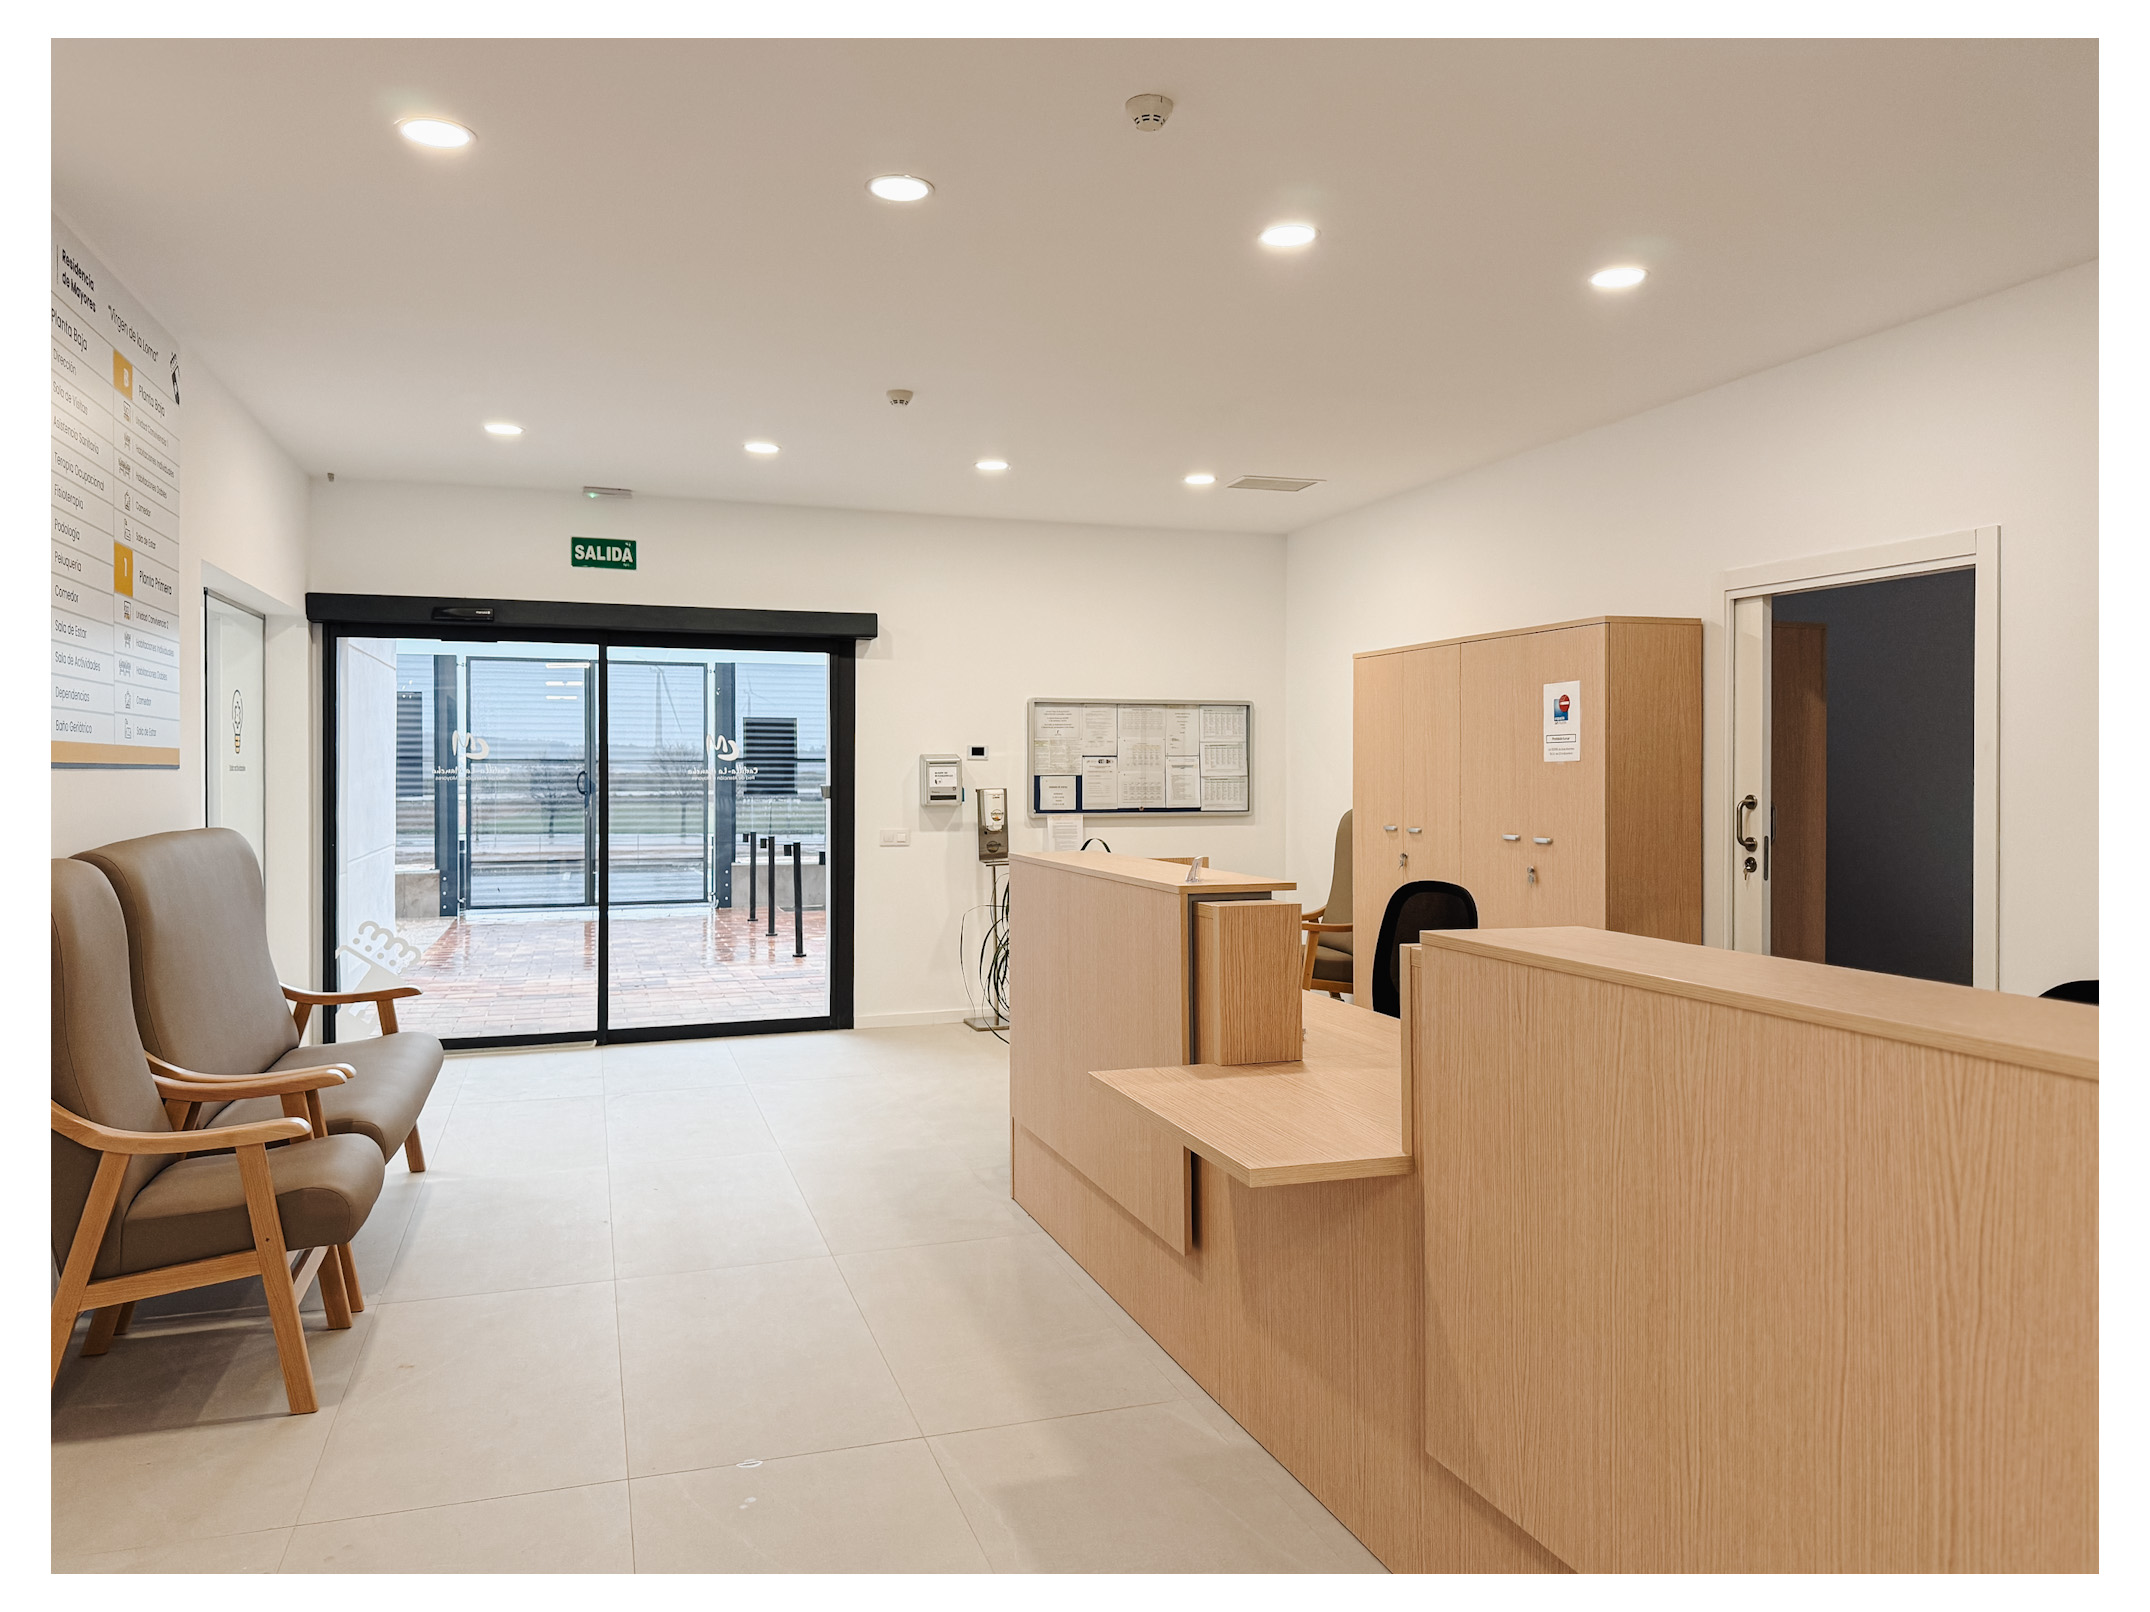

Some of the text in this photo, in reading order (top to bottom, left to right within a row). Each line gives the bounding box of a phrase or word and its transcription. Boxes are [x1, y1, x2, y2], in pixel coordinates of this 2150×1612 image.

[62, 249, 94, 291] Residencia
[62, 272, 96, 312] de Mayores
[51, 308, 87, 352] Planta Baja
[128, 325, 136, 342] de
[137, 332, 142, 348] la
[53, 348, 76, 375] Dirección
[53, 380, 64, 398] Sala
[65, 391, 71, 404] de
[139, 384, 165, 418] Planta Baja
[53, 415, 99, 454] Asistencia Sanitaria
[54, 452, 104, 491] Terapia Ocupacional
[54, 483, 84, 510] Fisioterapia
[54, 518, 80, 542] Podología
[54, 550, 82, 572] Peluquería
[575, 544, 634, 564] SALIDA
[123, 557, 128, 577] 1
[55, 584, 79, 603] Comedor
[139, 570, 172, 595] Planta Primera
[55, 620, 87, 639] Sala de Estar
[55, 651, 101, 672] Sala de Actividades
[55, 686, 90, 702] Dependencias
[55, 720, 93, 734] Baño Geriátrico
